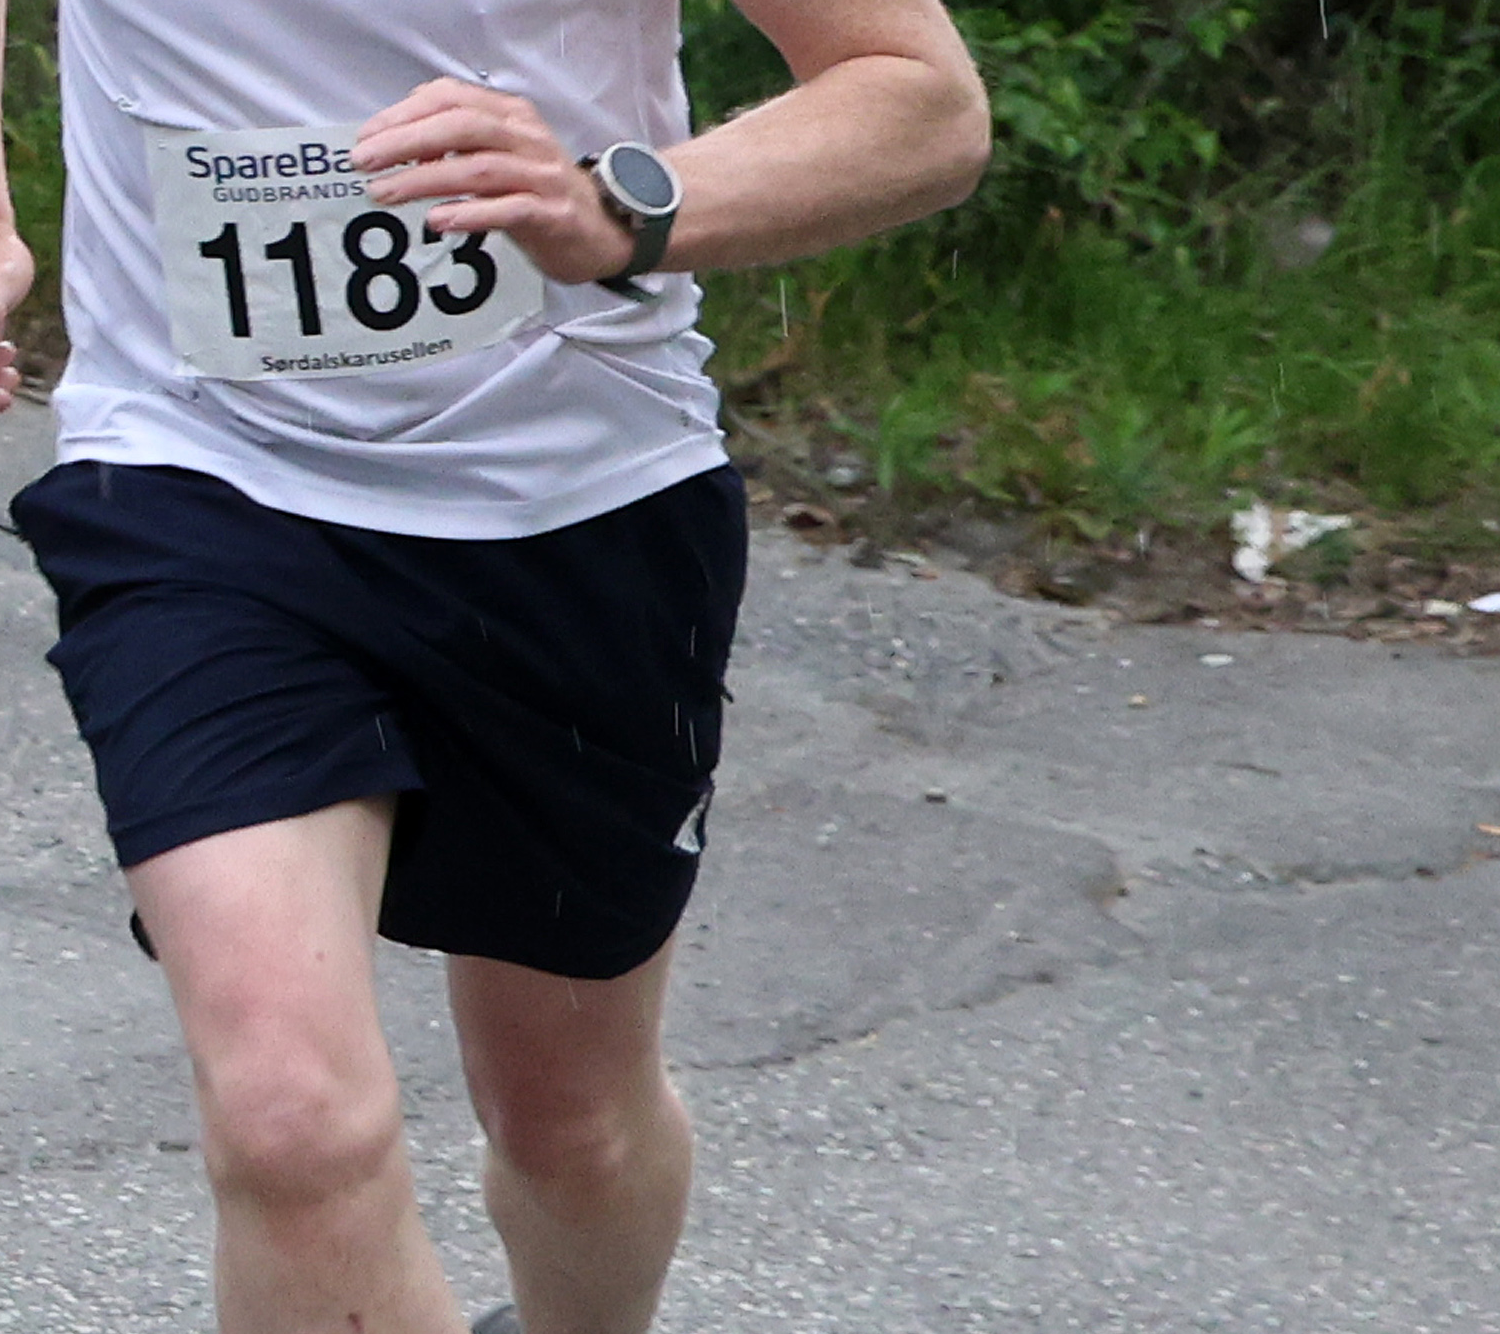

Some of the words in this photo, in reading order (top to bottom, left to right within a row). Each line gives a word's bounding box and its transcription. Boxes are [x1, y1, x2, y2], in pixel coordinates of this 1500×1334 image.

[186, 142, 355, 184] SpareBa
[213, 178, 373, 203] GUDBRANDS
[199, 211, 498, 338] 1183
[261, 337, 452, 373] Sørdalskarusellen
